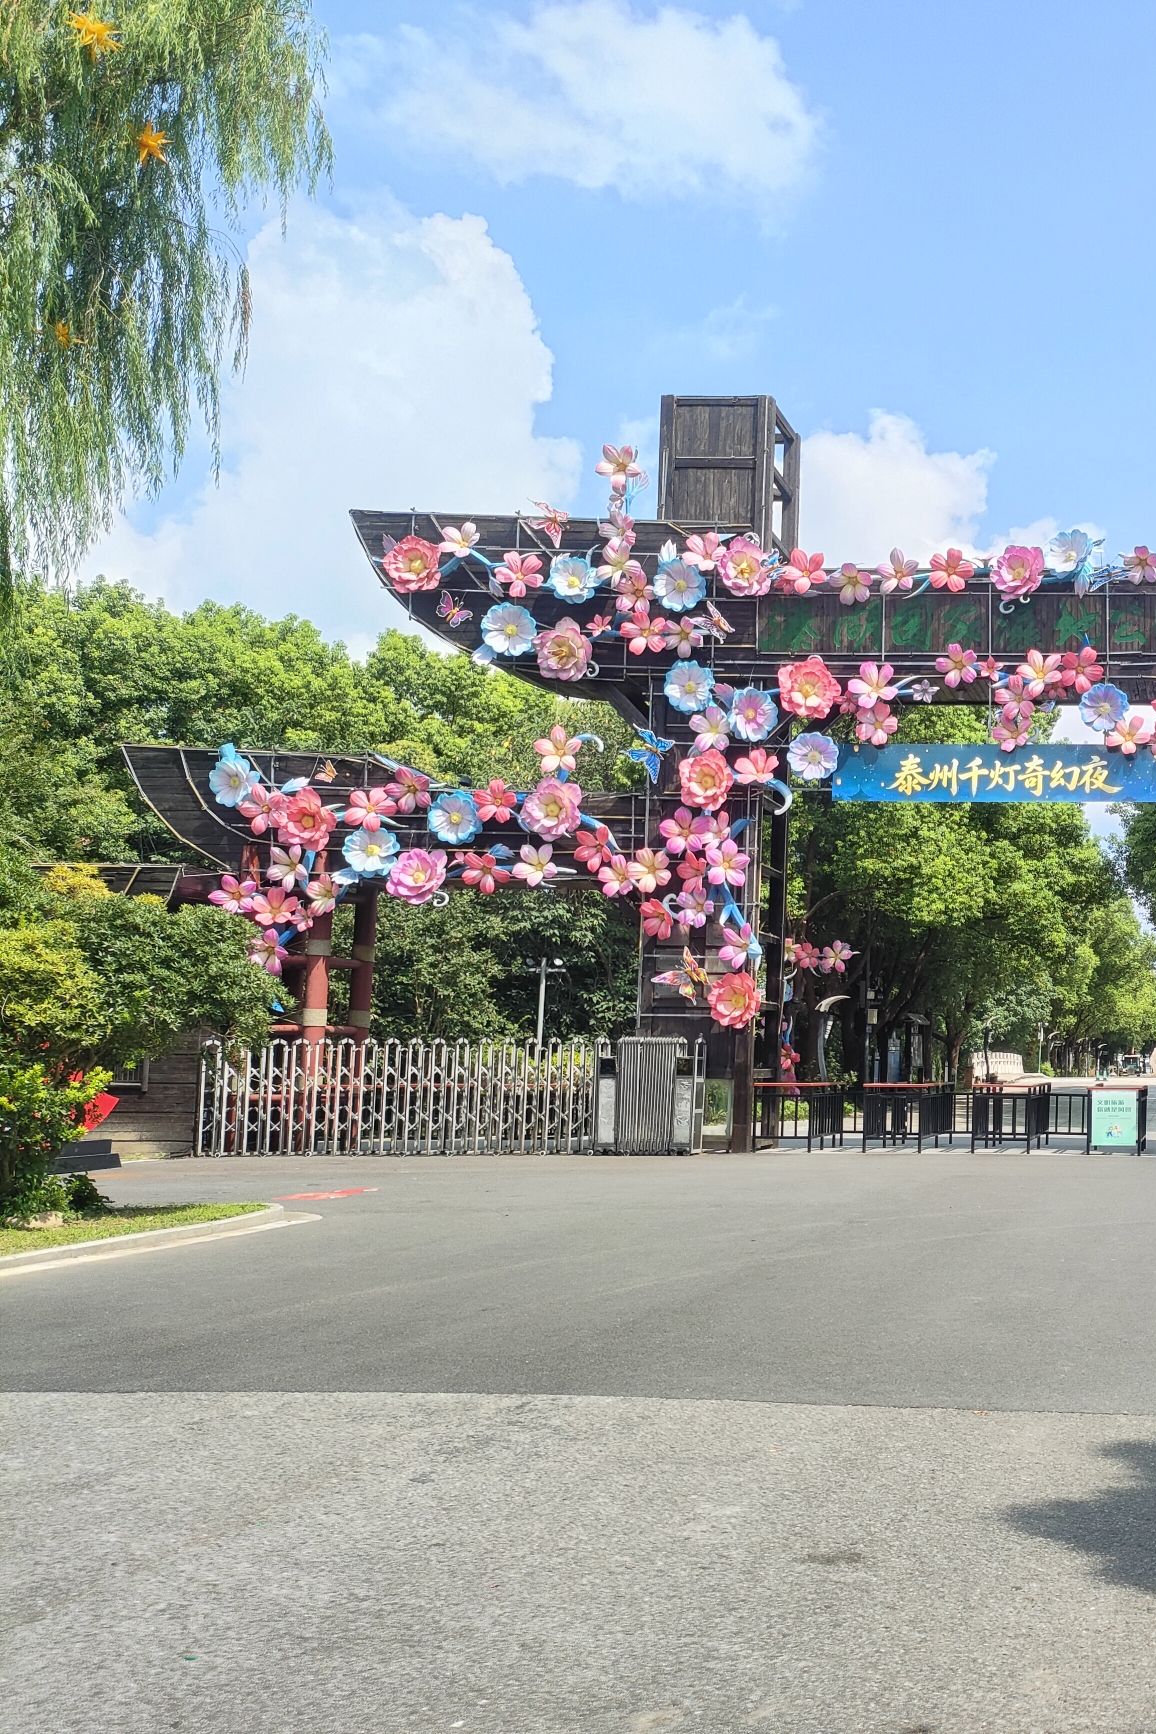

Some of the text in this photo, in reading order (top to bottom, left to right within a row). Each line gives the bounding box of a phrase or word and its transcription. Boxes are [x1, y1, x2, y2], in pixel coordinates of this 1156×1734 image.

[887, 753, 1124, 797] 泰州千灯奇幻夜
